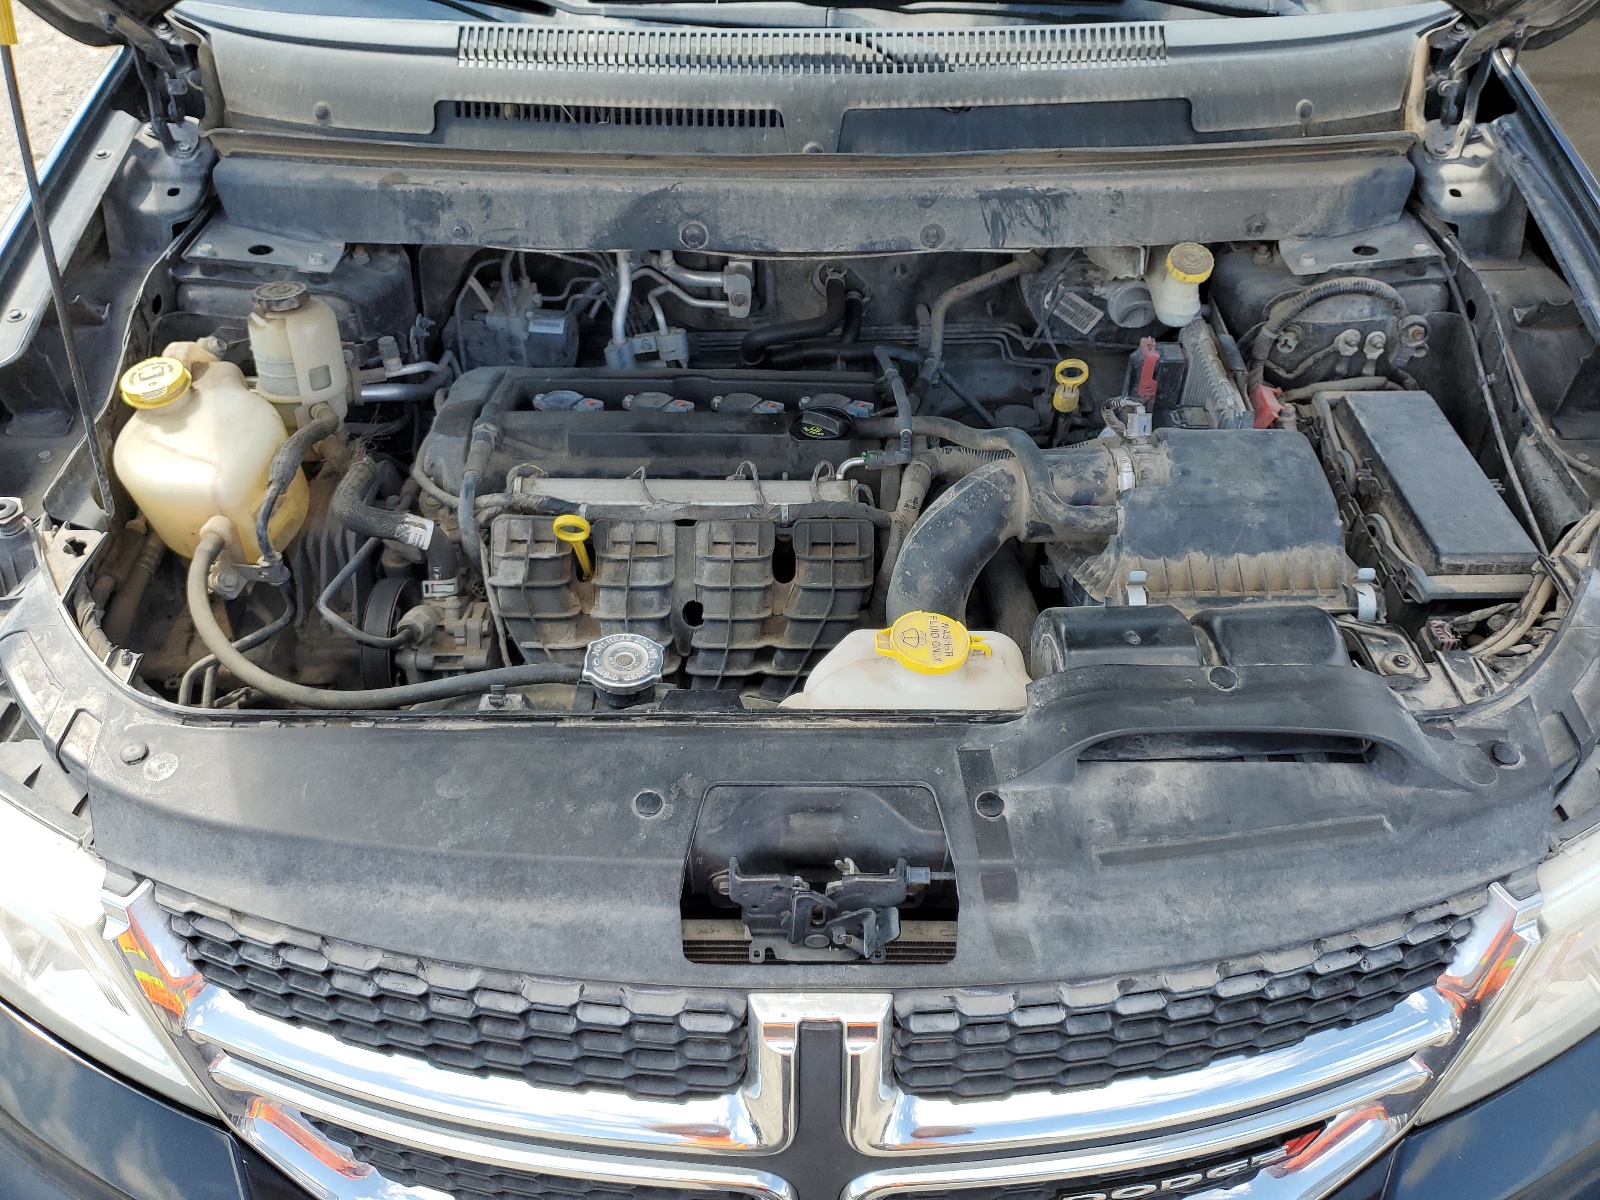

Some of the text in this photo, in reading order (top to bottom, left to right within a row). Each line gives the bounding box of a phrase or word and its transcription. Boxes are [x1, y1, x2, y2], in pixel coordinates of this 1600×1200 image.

[928, 615, 942, 662] FLUID ONLY
[941, 621, 954, 657] WASHER
